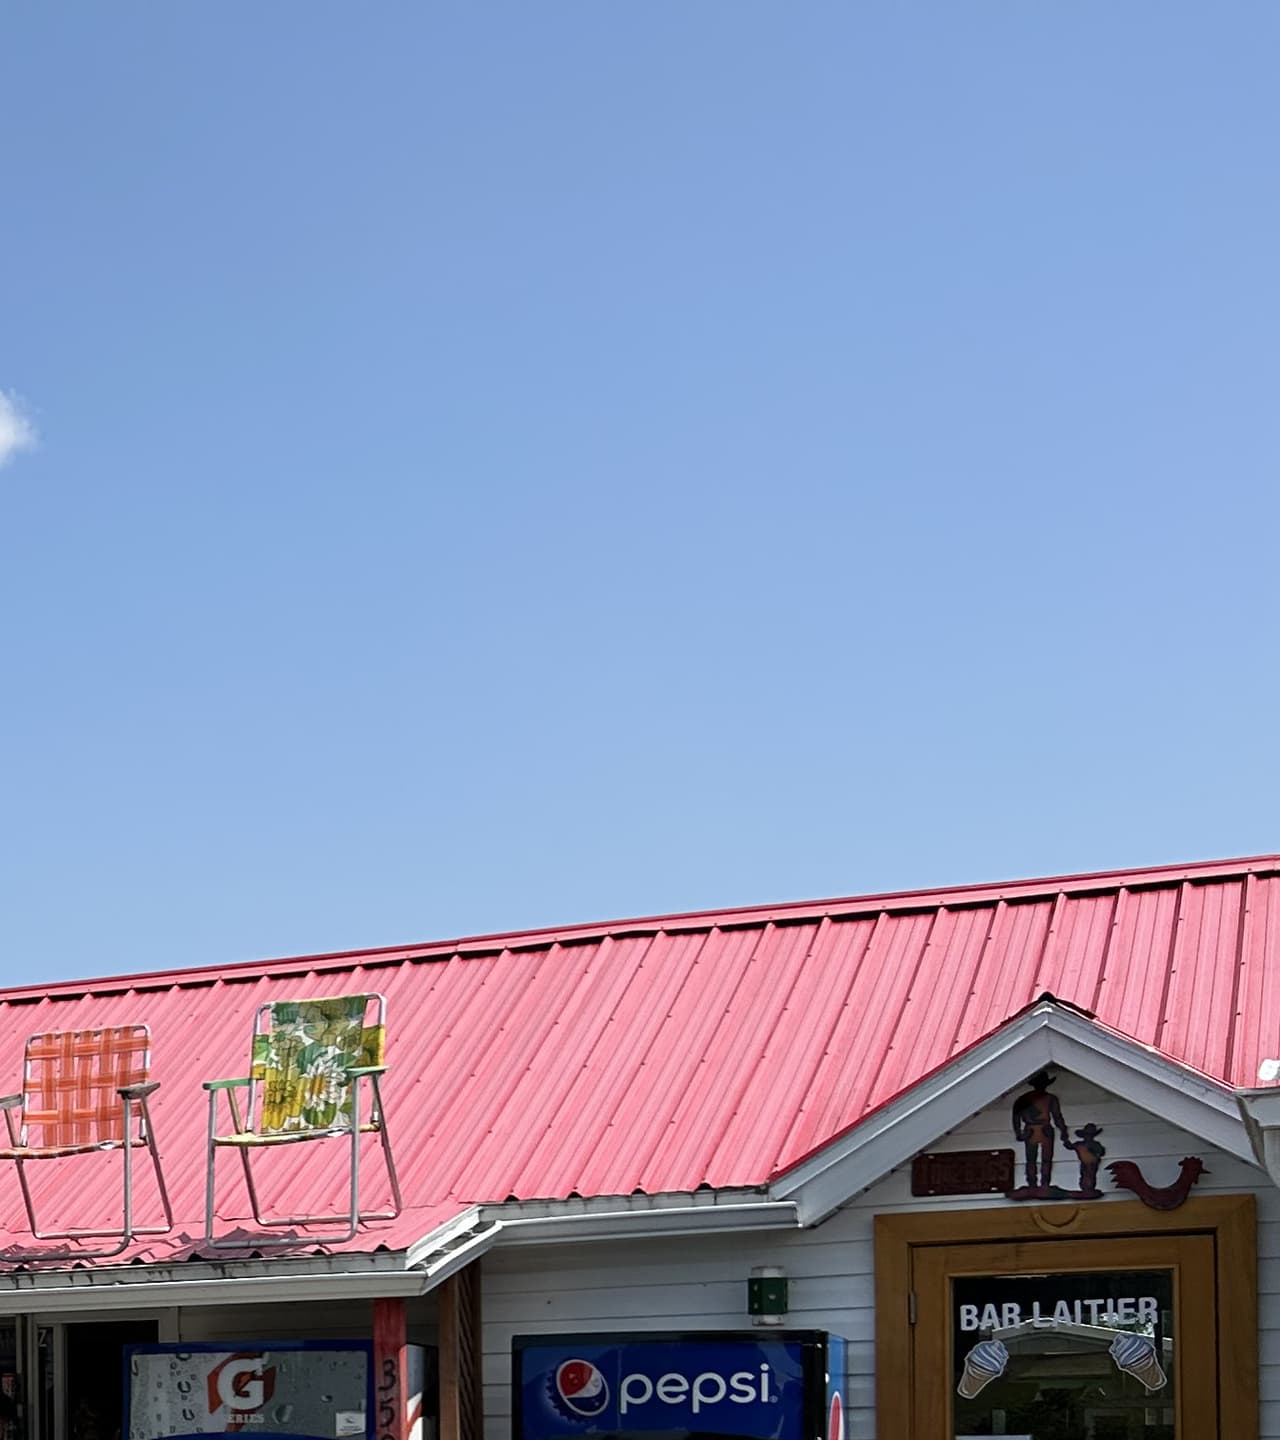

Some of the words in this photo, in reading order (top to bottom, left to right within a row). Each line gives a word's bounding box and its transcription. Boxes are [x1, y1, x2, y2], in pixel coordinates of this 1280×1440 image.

[959, 1302, 1021, 1331] BAR
[1032, 1297, 1158, 1328] LAITIER
[217, 1351, 270, 1411] G
[619, 1362, 770, 1415] pepsi
